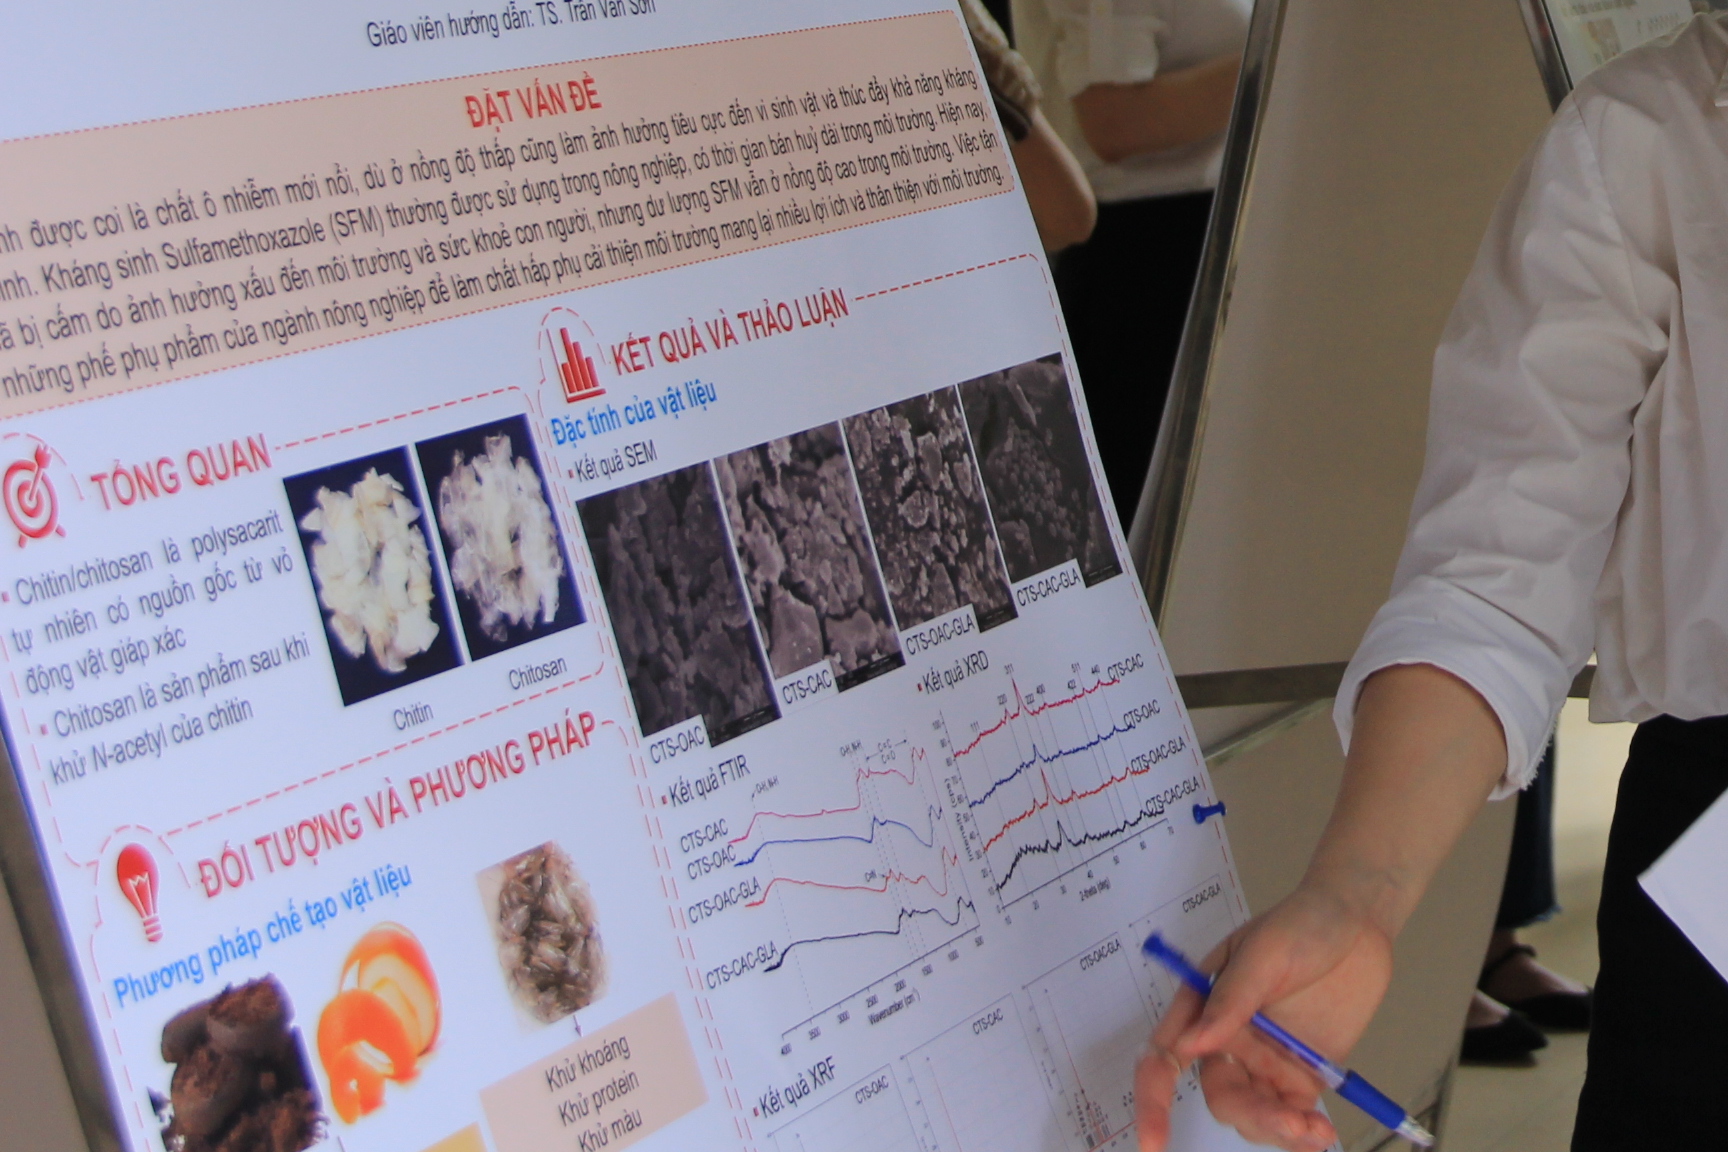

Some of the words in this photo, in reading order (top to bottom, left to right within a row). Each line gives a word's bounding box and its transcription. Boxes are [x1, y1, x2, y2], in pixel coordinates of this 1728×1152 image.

[368, 19, 408, 48] Giáo
[409, 14, 445, 41] viên
[446, 9, 500, 39] hướng
[500, 0, 534, 31] dẫn:
[534, 0, 563, 26] TS.
[463, 87, 513, 133] ĐẶT
[515, 77, 567, 119] VẤN
[566, 70, 602, 112] ĐỀ
[40, 258, 113, 293] Kháng
[114, 246, 160, 279] sinh
[160, 217, 326, 270] Sulfamethoxazole
[328, 205, 384, 245] (SFM)
[384, 197, 449, 229] thường
[449, 190, 494, 217] được
[495, 179, 517, 208] sử
[520, 177, 561, 205] dụng
[560, 171, 602, 196] trong
[601, 161, 640, 189] nông
[639, 151, 692, 185] nghiệp,
[692, 145, 710, 171] có
[710, 140, 739, 167] thời
[739, 137, 768, 167] gian
[766, 131, 795, 156] bán
[793, 124, 819, 154] huỷ
[819, 122, 841, 147] dài
[839, 121, 874, 144] trong
[872, 112, 896, 136] môi
[935, 100, 965, 126] Hiện
[610, 331, 654, 376] KẾT
[657, 316, 707, 363] QUẢ
[704, 308, 739, 350] VÀ
[736, 297, 793, 342] THẢO
[793, 286, 849, 328] LUẬN
[549, 415, 586, 448] Đặc
[585, 403, 622, 436] tính
[623, 394, 656, 425] của
[656, 385, 686, 419] vật
[683, 378, 717, 411] liệu
[89, 456, 181, 510] TỔNG
[185, 432, 271, 487] QUAN
[573, 452, 600, 482] Kết
[598, 447, 624, 480] quả
[623, 438, 657, 468] SEM
[13, 550, 153, 606] Chitin/chitosan
[160, 536, 181, 565] là
[189, 509, 284, 563] polysacarit
[1017, 568, 1081, 607] CTS-CAC-GLA
[906, 618, 976, 657] CTS-OAC-GLA
[508, 655, 568, 691] Chitosan
[782, 670, 833, 705] CTS-CAC
[921, 665, 945, 695] Kết
[942, 658, 965, 689] quả
[961, 649, 989, 677] XRD
[393, 700, 434, 732] Chitin
[649, 725, 706, 765] CTS-OAC
[196, 841, 254, 898] ĐỐI
[253, 802, 363, 873] TƯỢNG
[363, 786, 409, 829] VÀ
[408, 738, 525, 813] PHƯƠNG
[526, 707, 595, 766] PHÁP
[668, 775, 695, 807] Kết
[694, 766, 720, 800] quả
[716, 753, 750, 785] FTIR
[111, 953, 204, 1008] Phương
[206, 927, 262, 976] pháp
[264, 910, 303, 944] chế
[303, 896, 338, 929] tạo
[339, 876, 374, 912] vật
[372, 863, 412, 897] liệu
